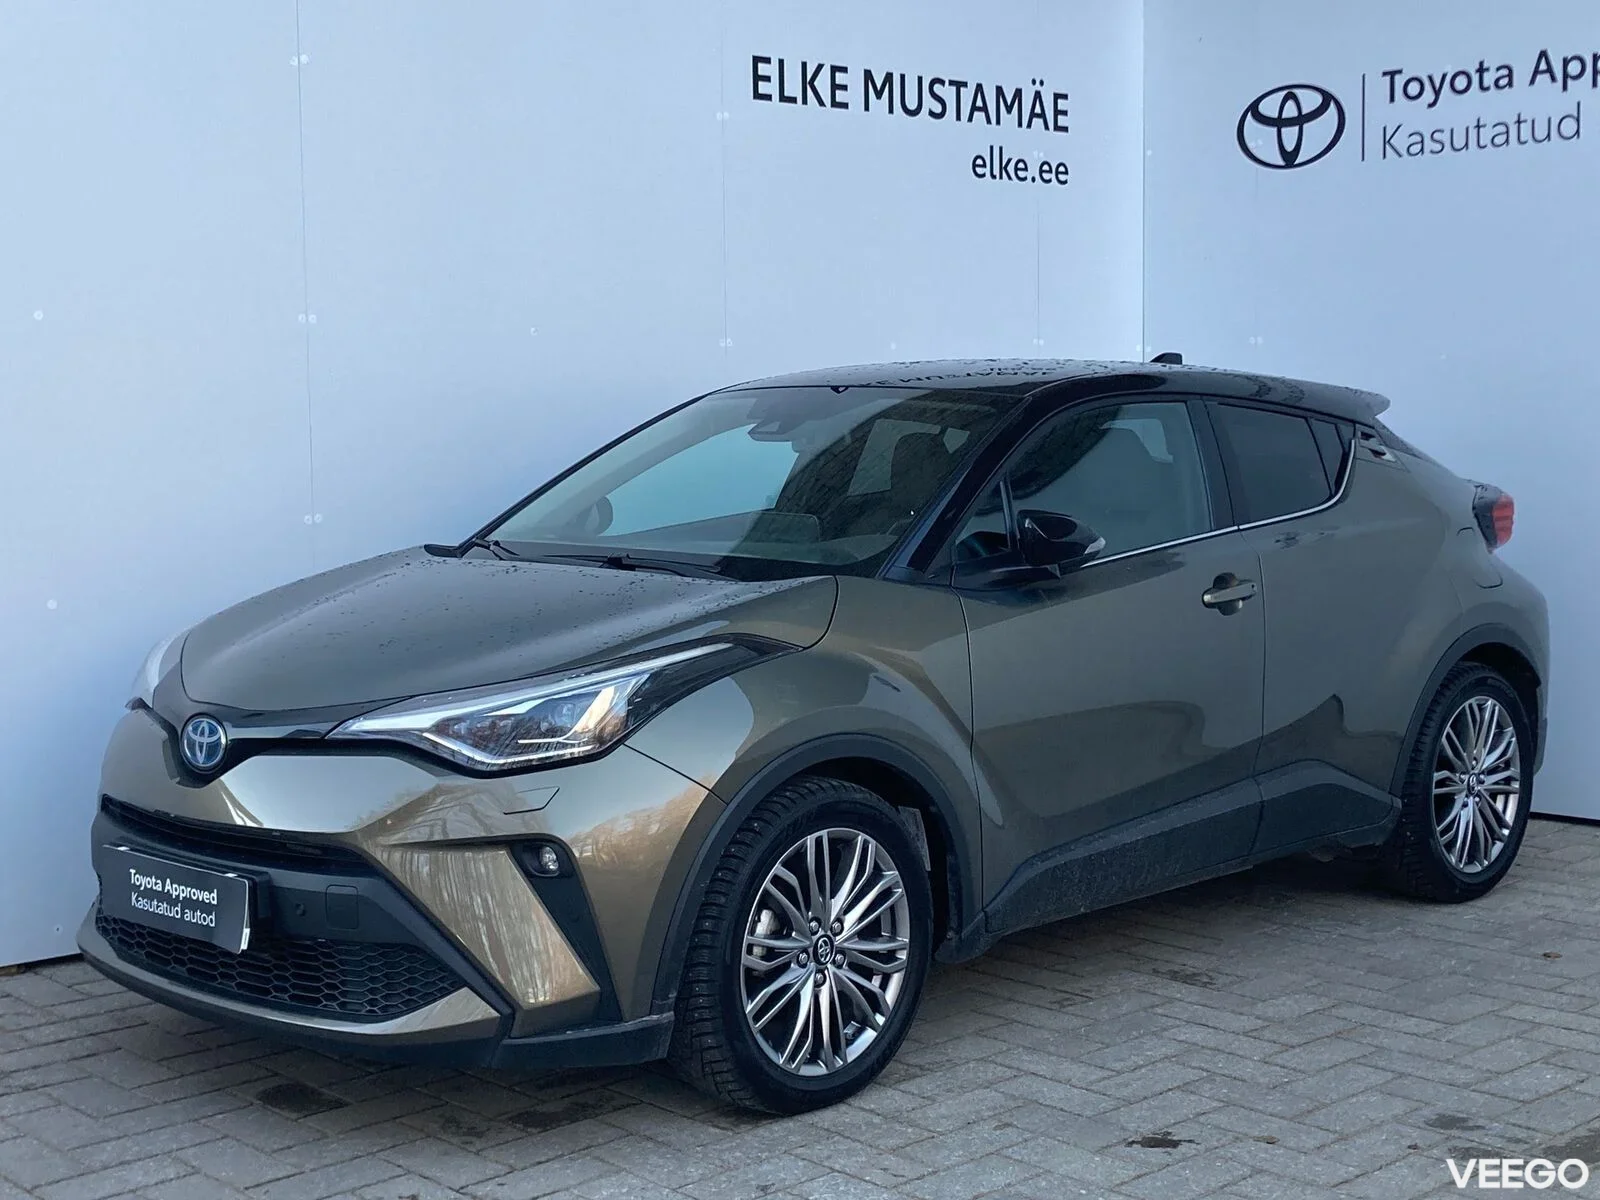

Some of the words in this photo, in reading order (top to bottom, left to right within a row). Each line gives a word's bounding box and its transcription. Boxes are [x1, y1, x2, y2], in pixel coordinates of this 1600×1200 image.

[752, 55, 849, 110] ELKE
[863, 68, 1069, 133] MUSTAMÄE
[1382, 60, 1515, 109] Toyota
[1382, 100, 1582, 160] Kasutatud
[971, 144, 1069, 186] elke.ee
[129, 868, 163, 891] Toyota
[164, 878, 218, 905] Approved
[131, 891, 181, 918] Kasutatud
[183, 906, 216, 927] autod
